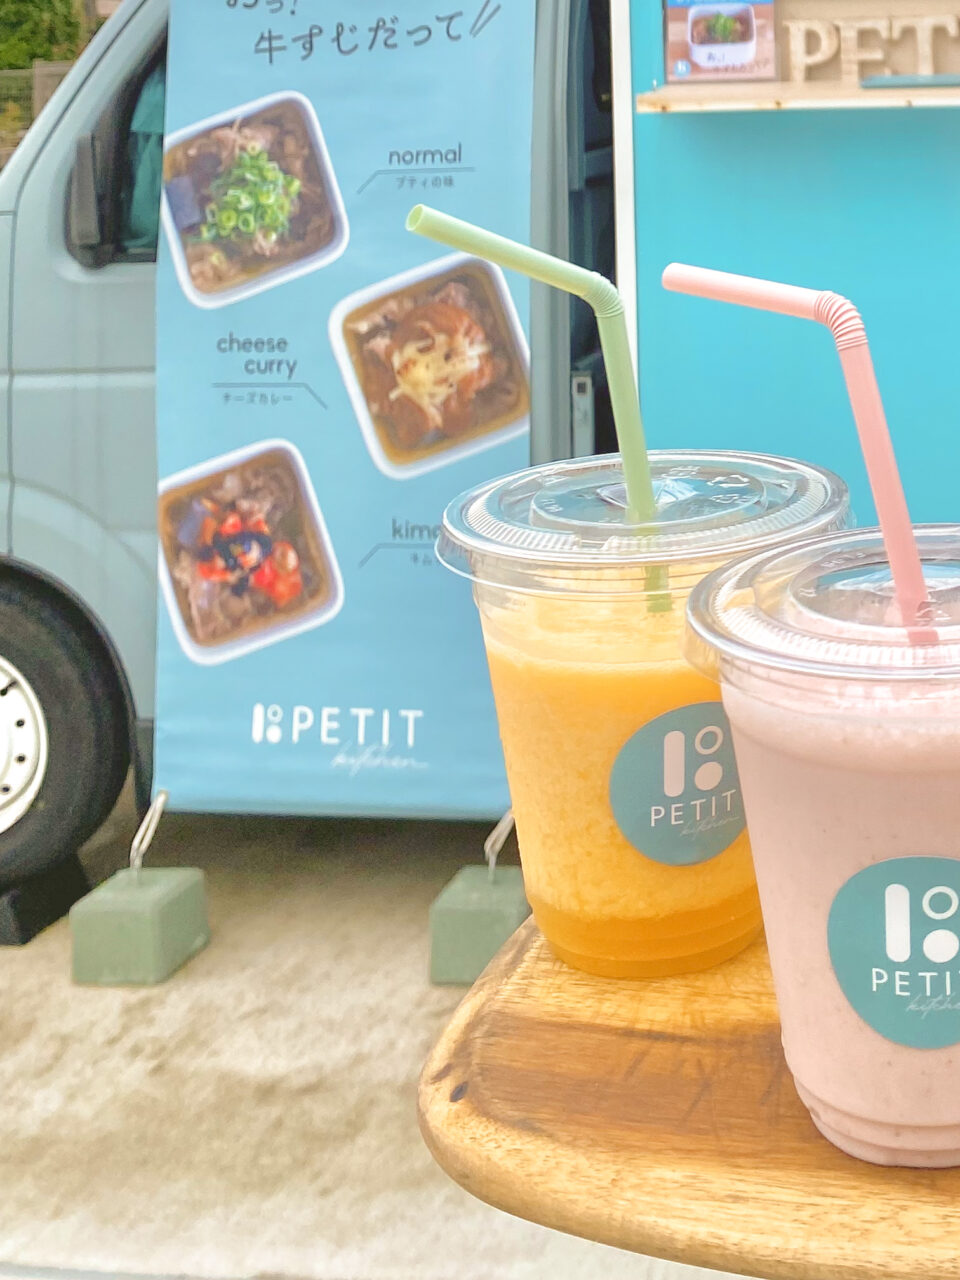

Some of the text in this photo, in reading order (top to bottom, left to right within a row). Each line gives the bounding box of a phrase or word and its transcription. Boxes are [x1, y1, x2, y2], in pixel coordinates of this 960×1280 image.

[388, 141, 462, 165] normal
[216, 330, 288, 353] cheese
[244, 358, 298, 380] curry
[291, 704, 424, 748] PETIT
[650, 789, 737, 828] PETIT
